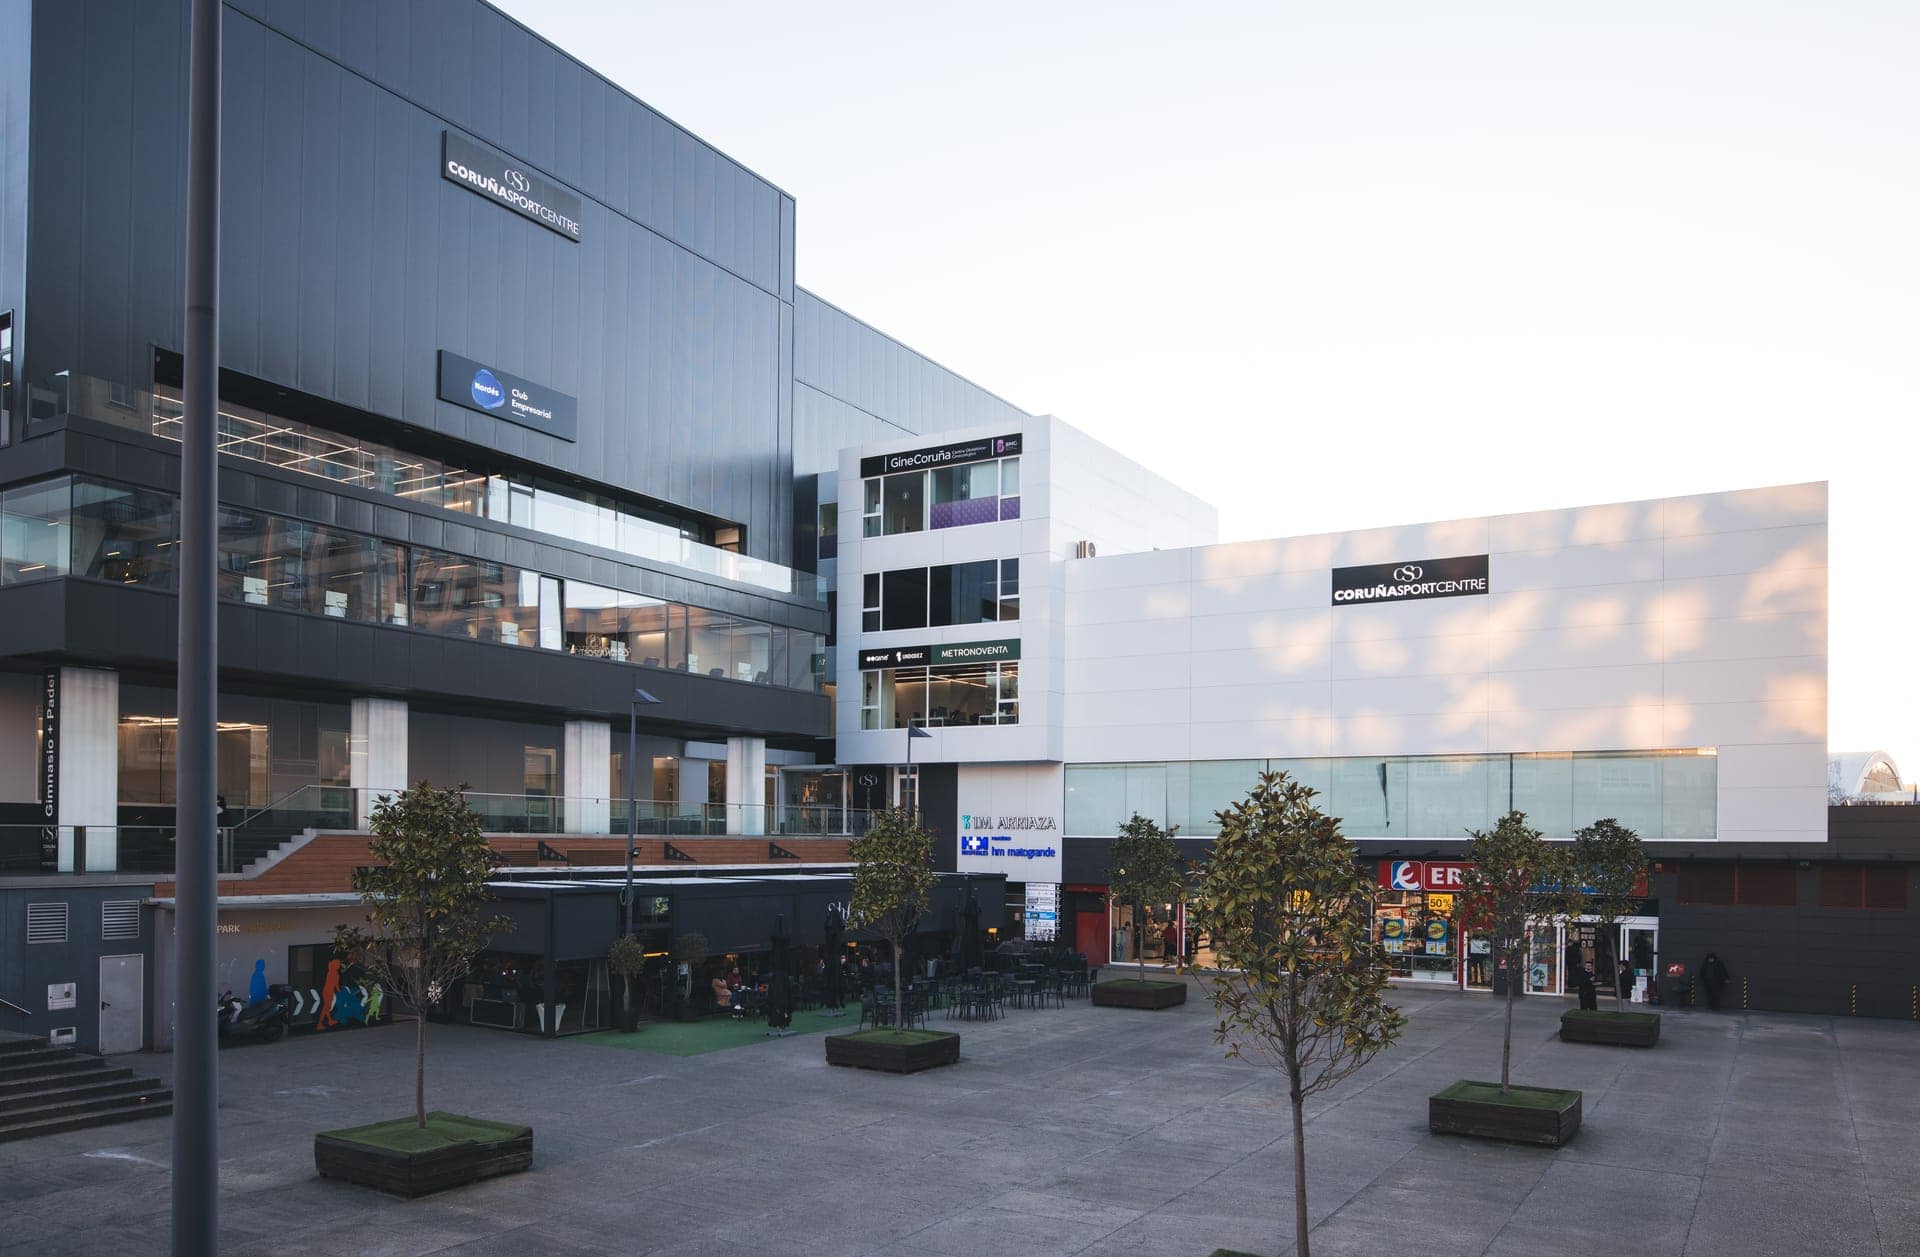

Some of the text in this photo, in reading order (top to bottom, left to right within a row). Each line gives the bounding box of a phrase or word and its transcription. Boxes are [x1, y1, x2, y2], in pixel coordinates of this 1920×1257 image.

[511, 388, 529, 401] Club
[511, 399, 552, 419] Empresarial
[890, 450, 951, 468] GineCoruña
[1334, 578, 1486, 601] CORUÑASPORTCENTRE
[941, 645, 1008, 658] METRONOVENTA
[45, 738, 55, 817] Gimnasio
[998, 816, 1057, 830] ARRIAZA
[991, 847, 1005, 857] hm
